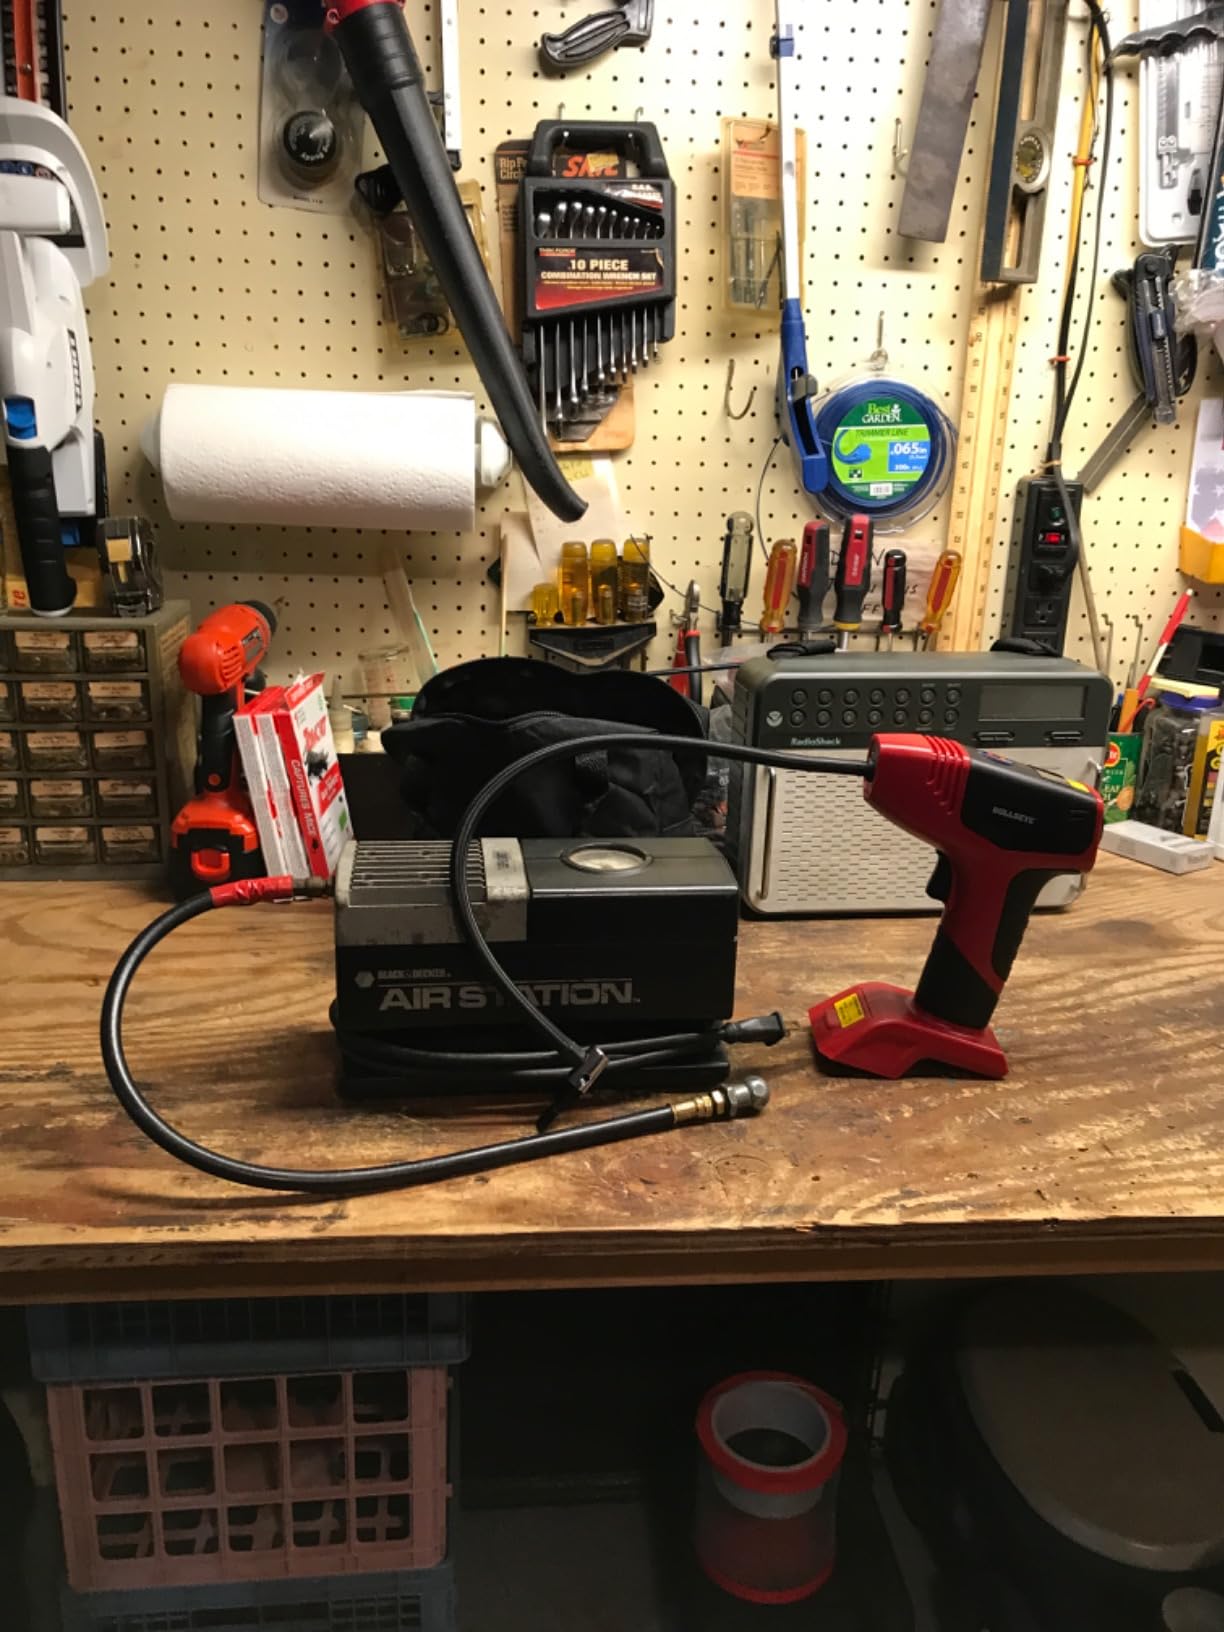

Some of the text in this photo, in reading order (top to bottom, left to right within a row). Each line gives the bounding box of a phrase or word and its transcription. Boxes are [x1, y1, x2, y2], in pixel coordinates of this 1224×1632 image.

[570, 259, 629, 271] 10 PIECE
[541, 271, 657, 281] COMBINATION WRENCH SET
[868, 402, 891, 414] Best
[862, 413, 901, 423] GARDEN
[790, 736, 841, 745] RadioShack
[379, 986, 452, 1010] AIR
